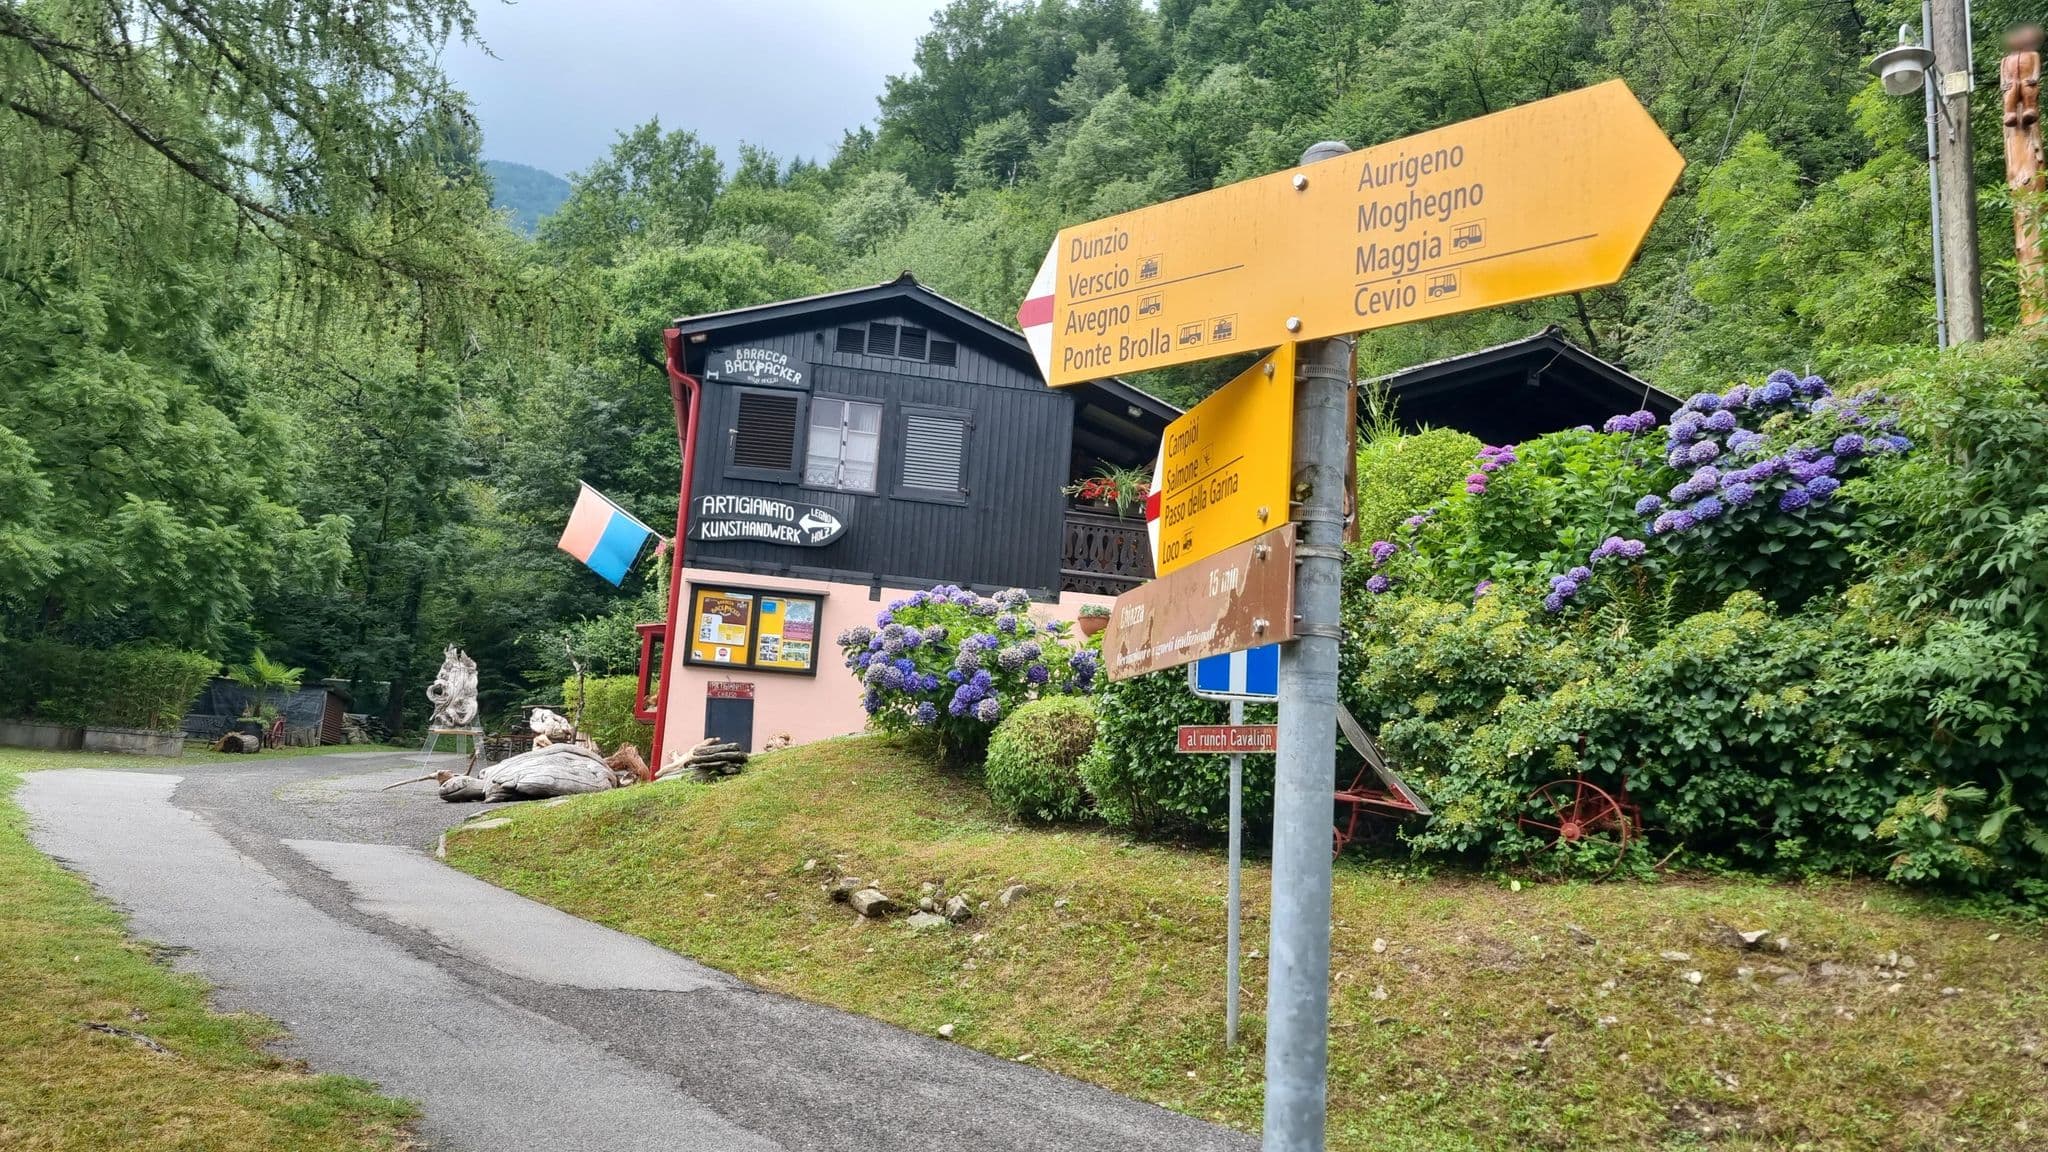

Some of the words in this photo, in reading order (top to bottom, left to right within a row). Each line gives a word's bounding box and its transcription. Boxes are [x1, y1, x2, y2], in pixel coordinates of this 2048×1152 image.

[1358, 145, 1464, 192] Aurigeno
[1358, 183, 1484, 233] Moghegno
[1070, 227, 1129, 263] Dunzio
[1356, 230, 1442, 276] Maggia
[1068, 263, 1129, 299] Verscio
[1354, 279, 1417, 317] Cevio
[1064, 304, 1131, 337] Avegno
[736, 348, 788, 365] BARACCA
[1063, 343, 1112, 373] Ponte
[1119, 327, 1171, 362] Brolla
[725, 360, 802, 385] BACKPACKER
[1166, 457, 1199, 494] Salmone
[702, 496, 795, 521] ARTIGIANATO
[810, 508, 832, 523] LEGNO
[1164, 500, 1185, 529] Passo
[1187, 485, 1207, 516] della
[1209, 471, 1239, 504] Garina
[701, 520, 801, 544] KUNSTHANDWERK
[811, 527, 831, 544] HOLZ
[1162, 540, 1180, 565] Loco
[1208, 568, 1219, 598] 15
[1221, 563, 1239, 593] min
[1187, 729, 1197, 746] al
[1200, 729, 1227, 746] runch
[1230, 729, 1272, 751] Cavalign
